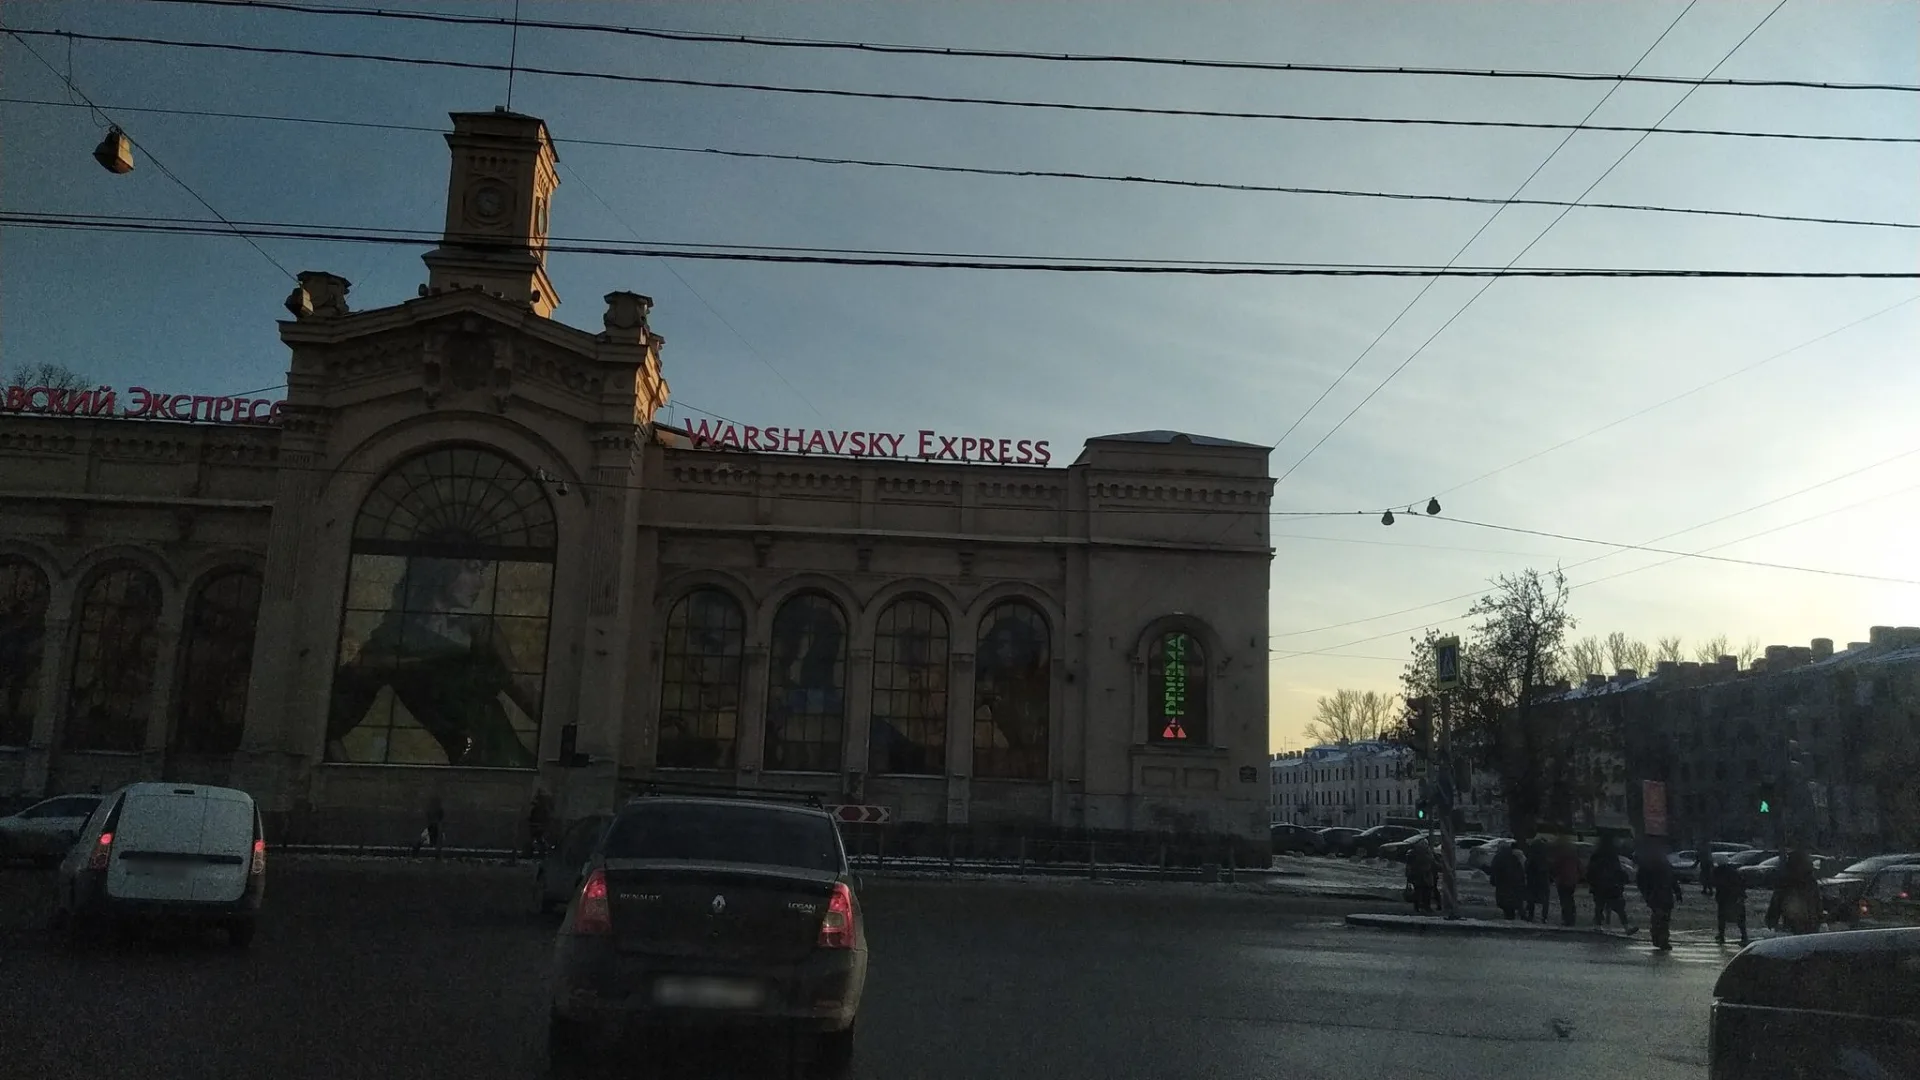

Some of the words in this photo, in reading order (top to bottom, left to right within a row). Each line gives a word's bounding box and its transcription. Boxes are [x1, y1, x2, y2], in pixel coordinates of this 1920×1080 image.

[684, 418, 905, 456] WARSHAVSKY
[918, 430, 1051, 465] EXPRESS
[788, 902, 817, 911] LOGAN
